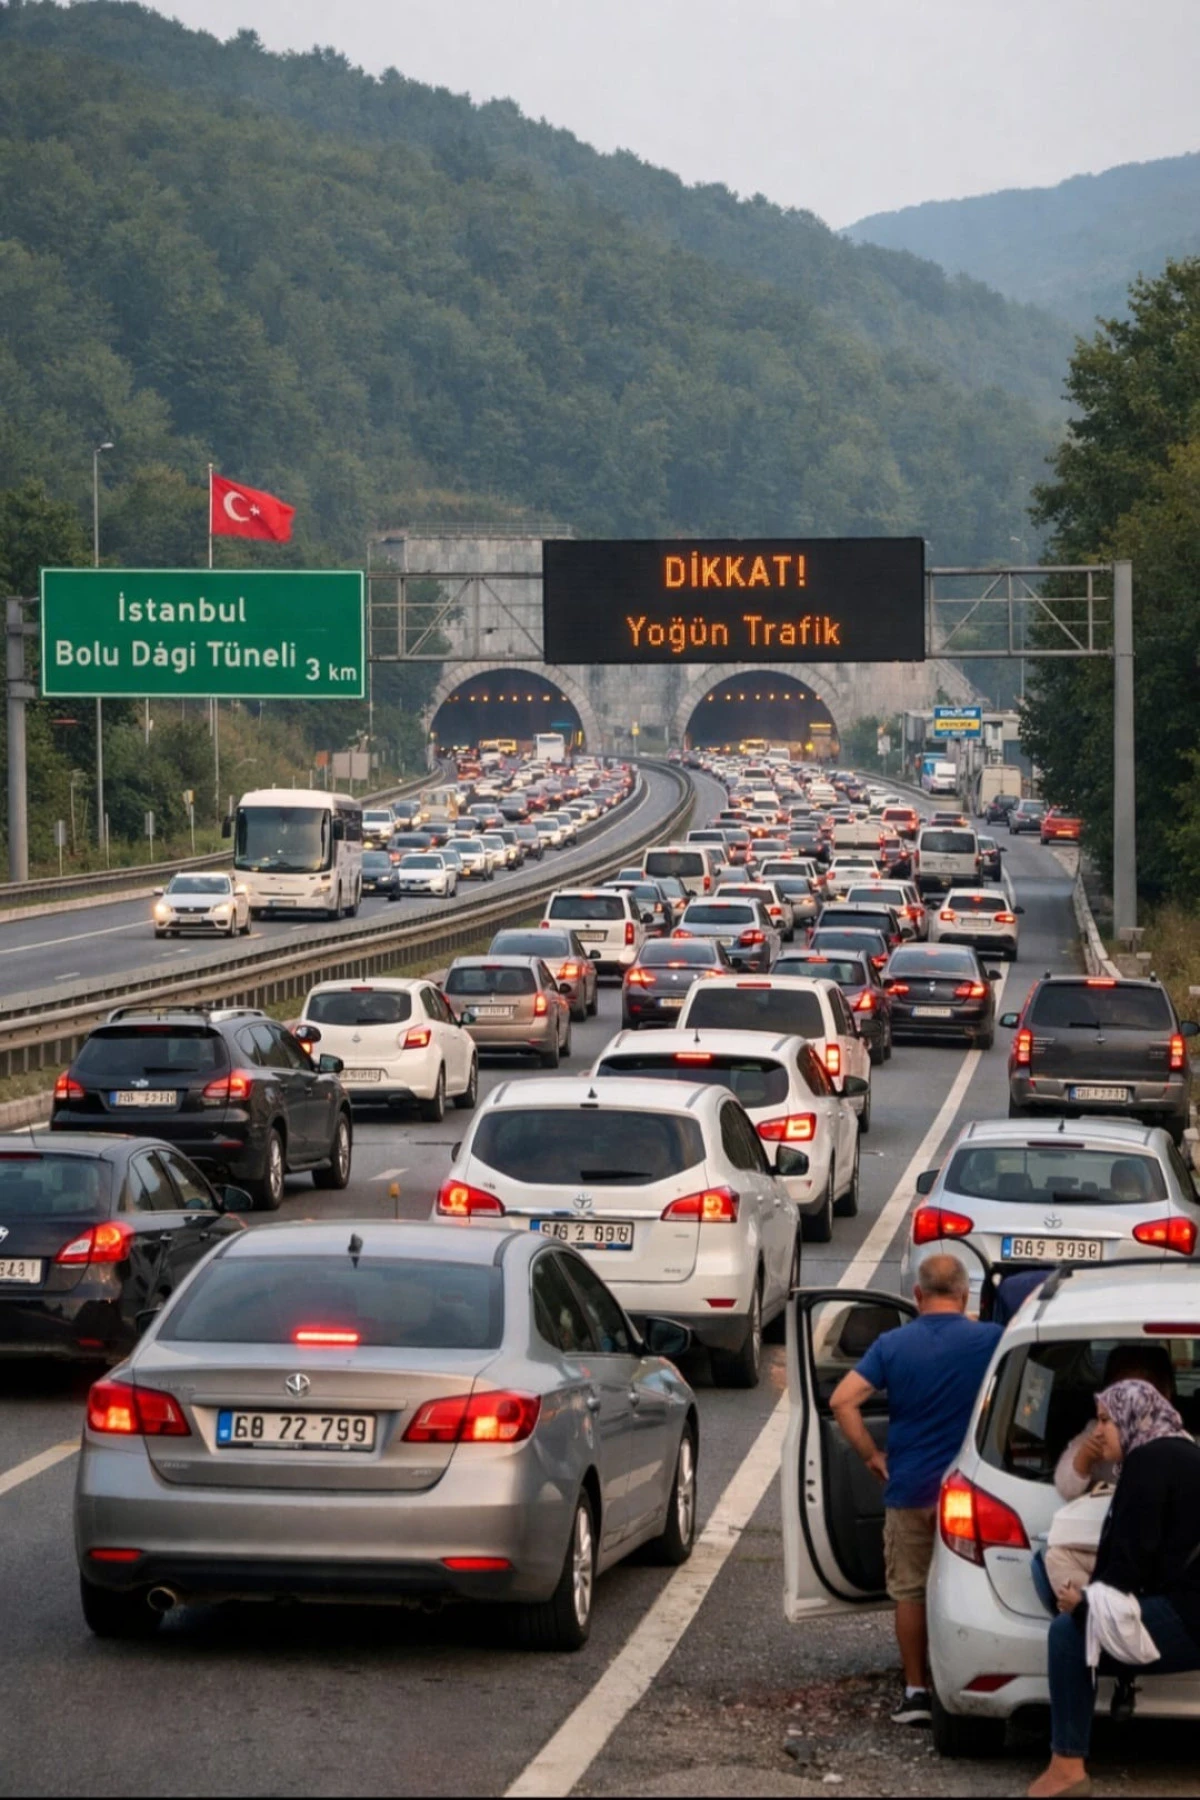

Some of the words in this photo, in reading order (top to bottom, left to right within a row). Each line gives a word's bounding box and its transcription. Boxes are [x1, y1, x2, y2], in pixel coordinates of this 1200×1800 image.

[665, 551, 806, 588] DİKKAT!
[119, 592, 246, 622] İstanbul
[743, 615, 840, 645] Trafik
[56, 640, 119, 666] Bolu
[207, 641, 296, 667] Tüneli
[306, 658, 320, 680] 3
[329, 664, 357, 680] km
